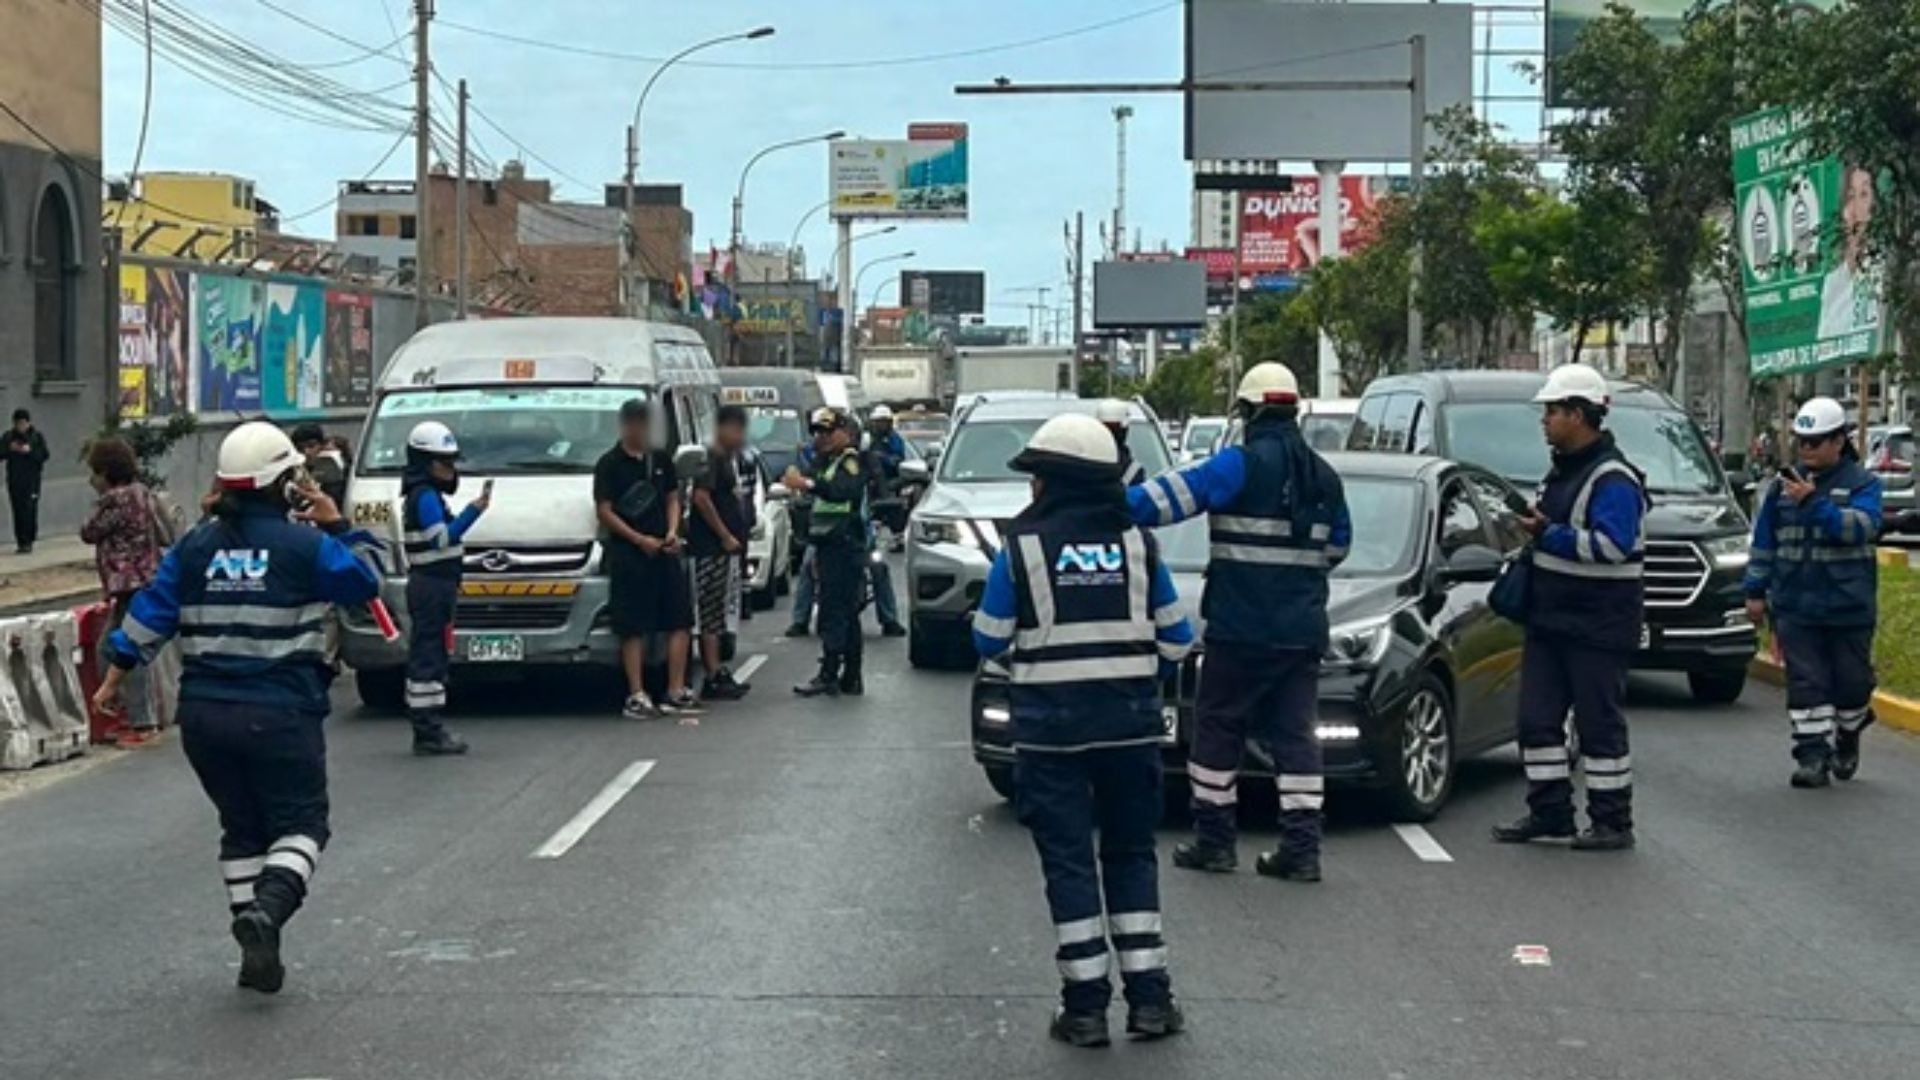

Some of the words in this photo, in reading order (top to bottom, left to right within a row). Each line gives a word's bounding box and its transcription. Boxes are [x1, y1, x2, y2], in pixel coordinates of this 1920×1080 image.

[744, 388, 775, 402] LIMA
[204, 548, 269, 580] ATU
[1055, 543, 1122, 572] ATU
